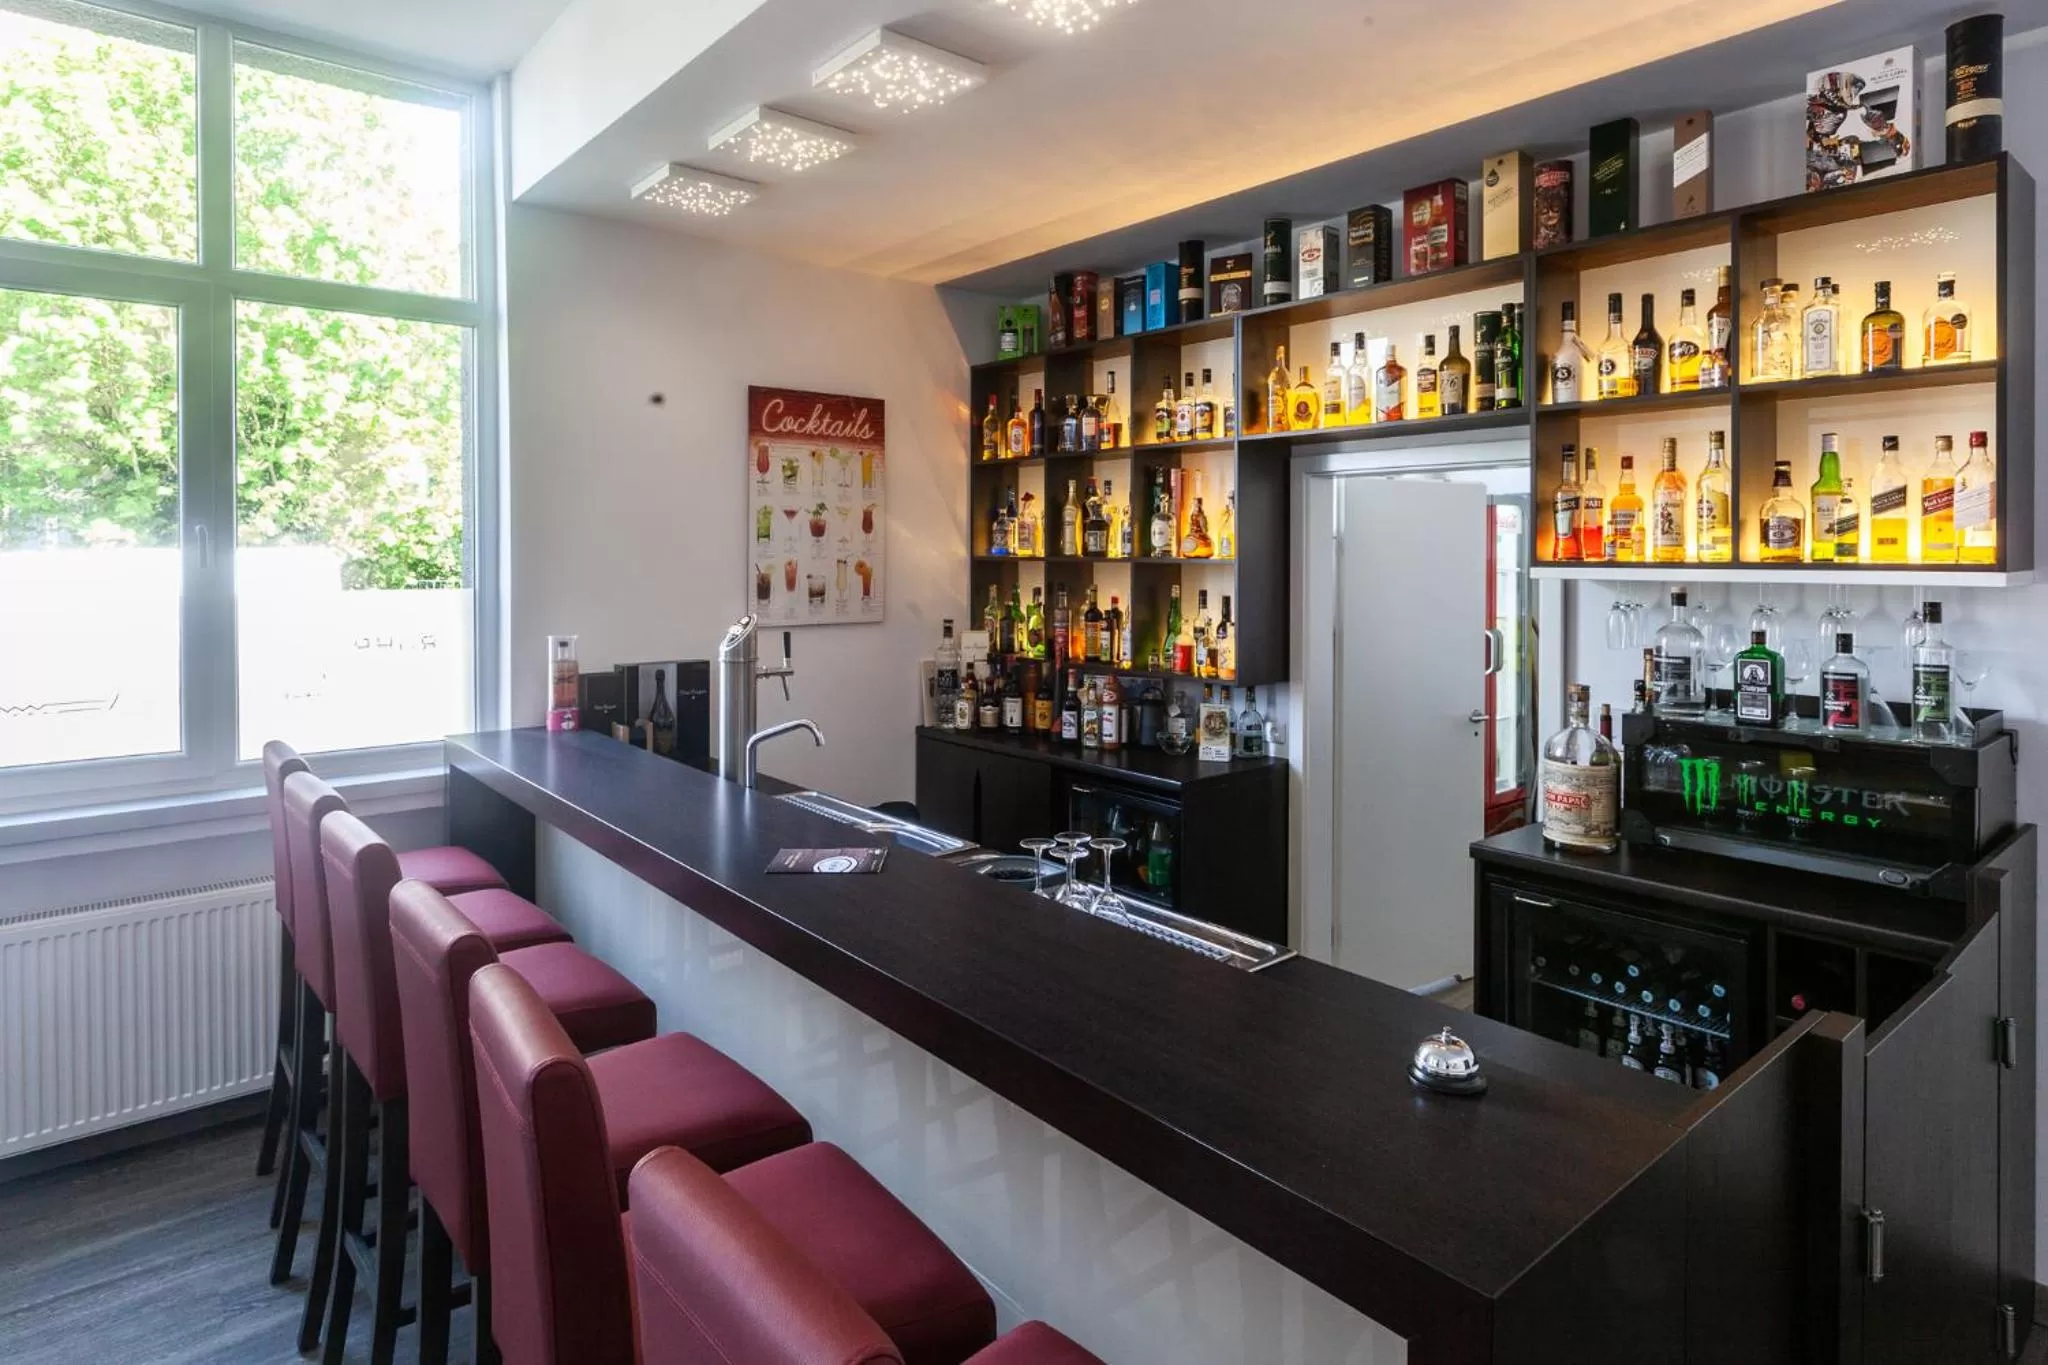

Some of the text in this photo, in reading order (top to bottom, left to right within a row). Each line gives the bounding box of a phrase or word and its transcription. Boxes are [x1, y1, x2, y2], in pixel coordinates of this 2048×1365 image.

[762, 399, 875, 439] Cocktails
[1729, 772, 1909, 816] MONSTER
[1755, 801, 1883, 828] ENERGY
